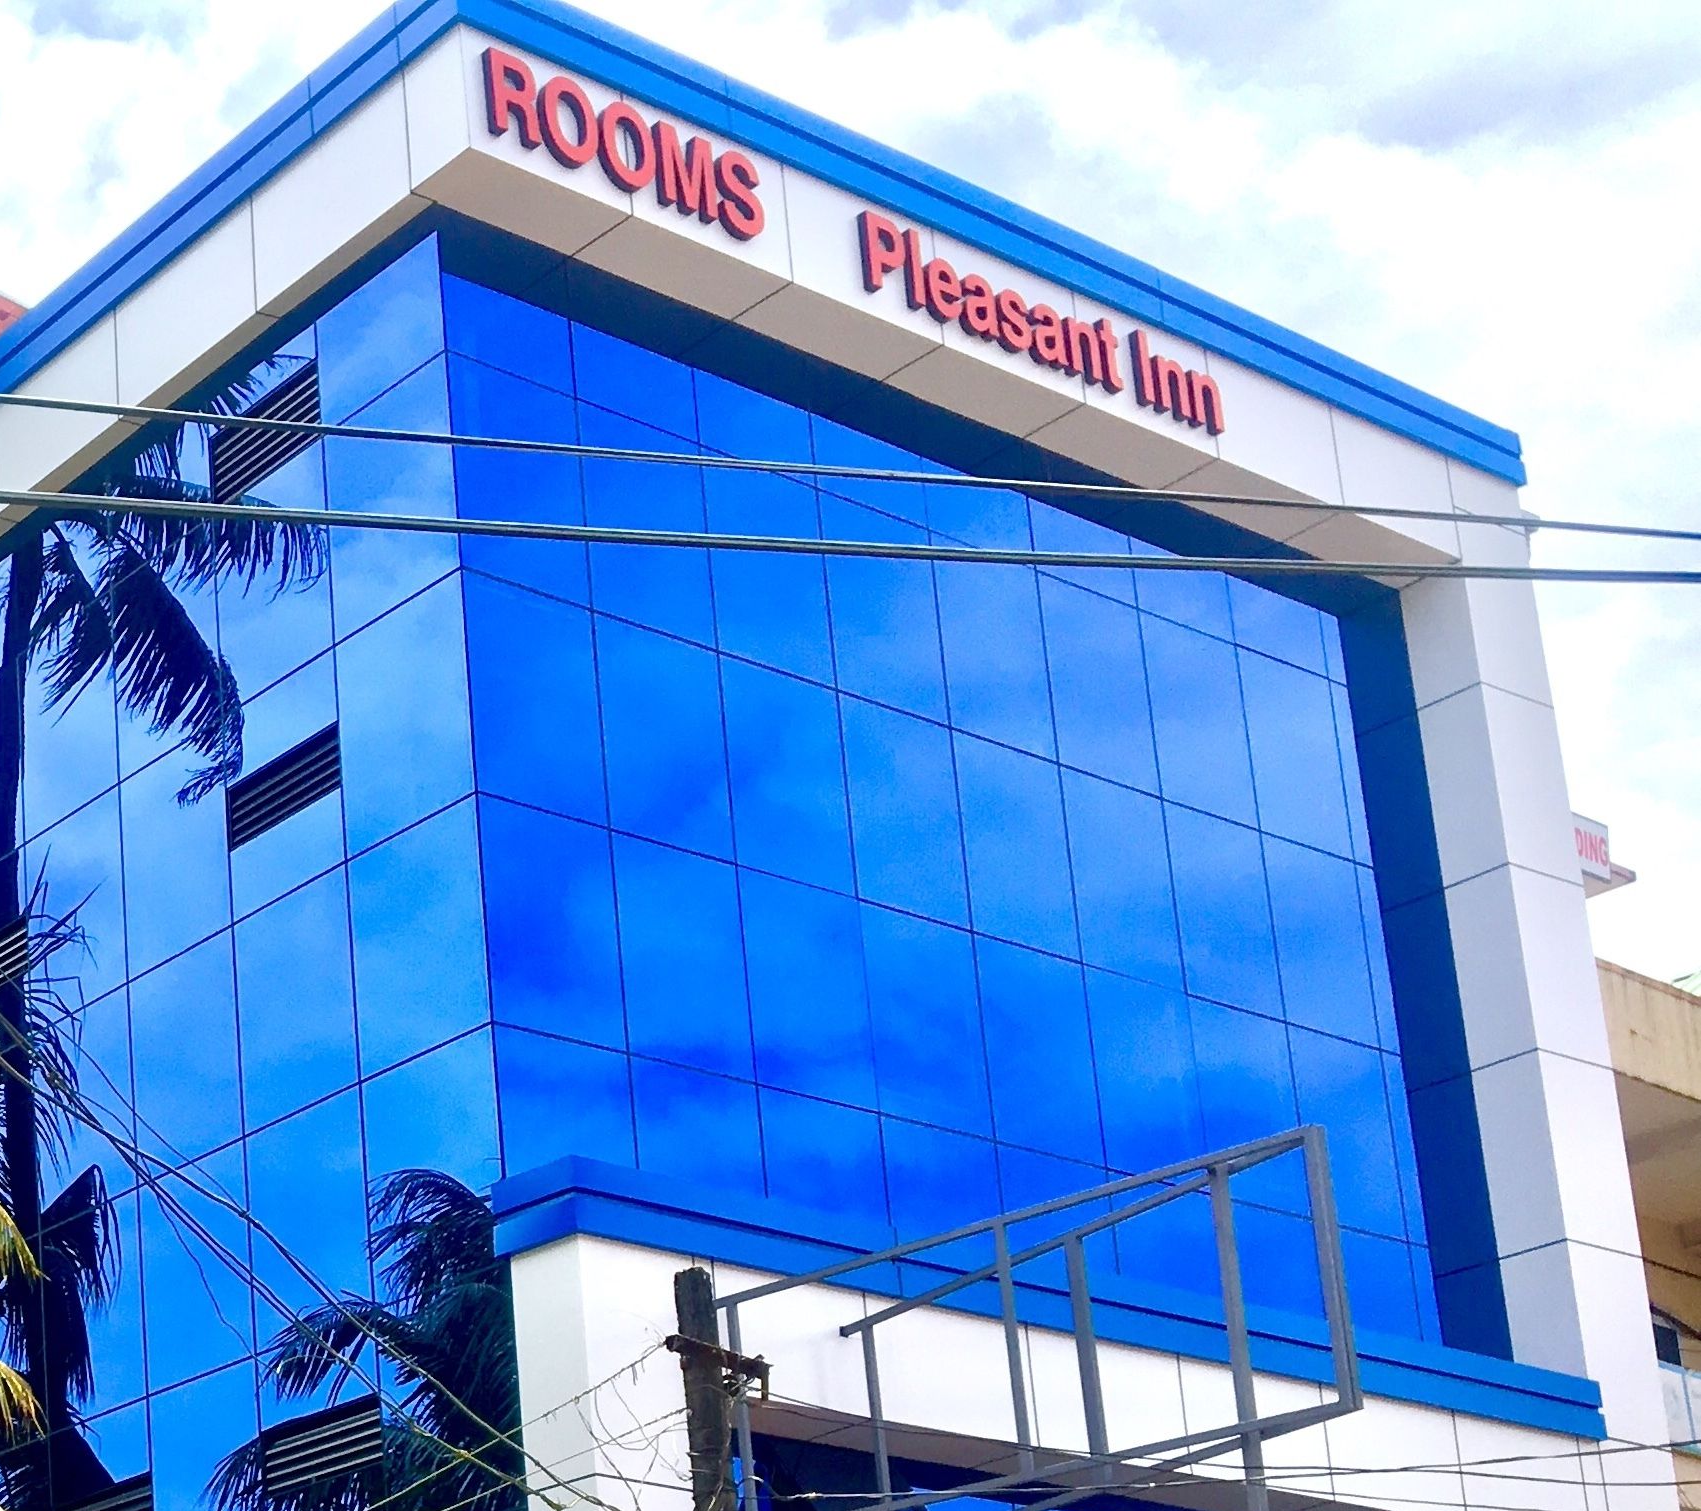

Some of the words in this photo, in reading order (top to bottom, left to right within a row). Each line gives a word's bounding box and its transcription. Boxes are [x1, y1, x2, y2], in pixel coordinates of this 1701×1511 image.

[482, 46, 765, 241] ROOMS
[857, 210, 1124, 394] Pleasant
[1129, 328, 1226, 436] Inn
[1574, 827, 1609, 867] DING
